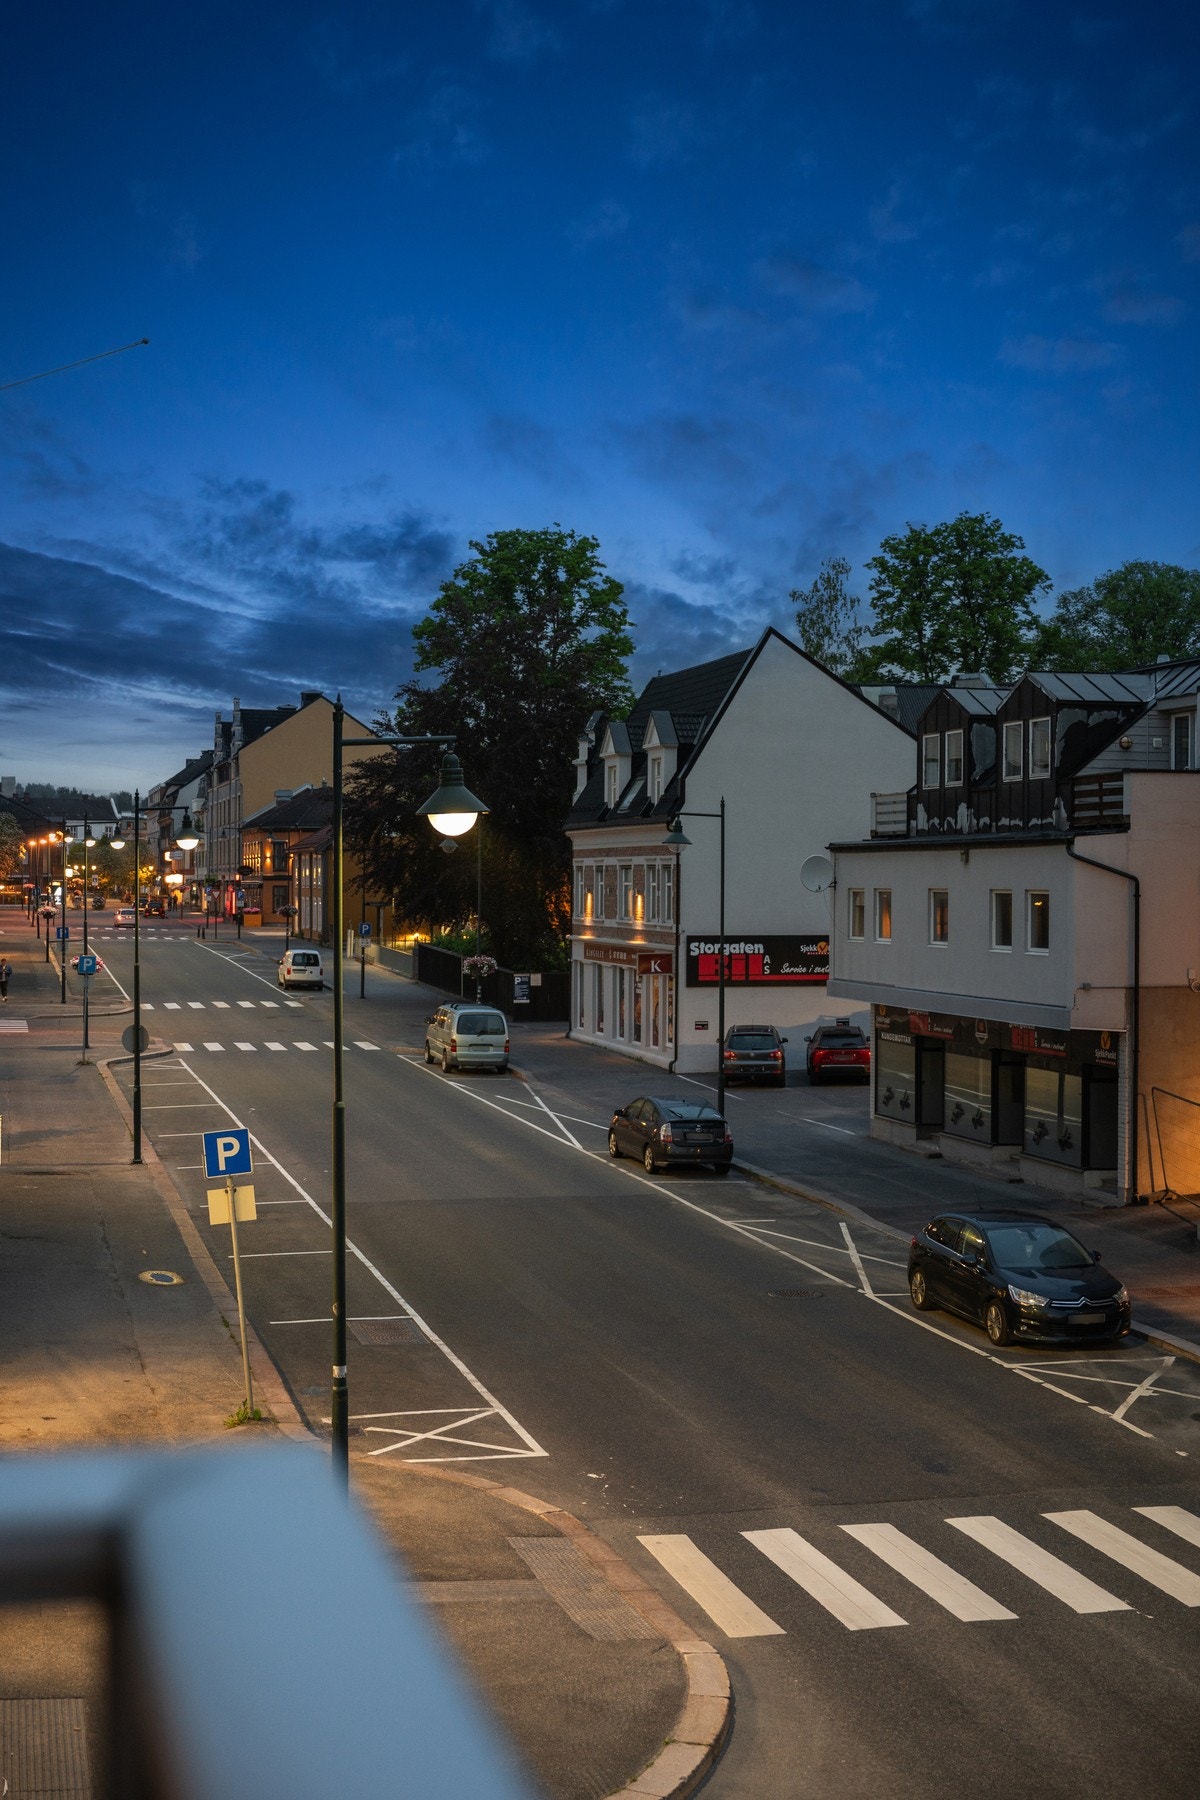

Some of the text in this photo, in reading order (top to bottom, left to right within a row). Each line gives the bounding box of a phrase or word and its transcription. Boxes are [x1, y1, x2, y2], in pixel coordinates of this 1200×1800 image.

[362, 924, 370, 934] P
[690, 942, 764, 956] Storgaten
[83, 958, 92, 971] P
[650, 960, 662, 973] K
[780, 962, 807, 973] Service
[514, 977, 522, 985] P
[216, 1136, 241, 1171] P
